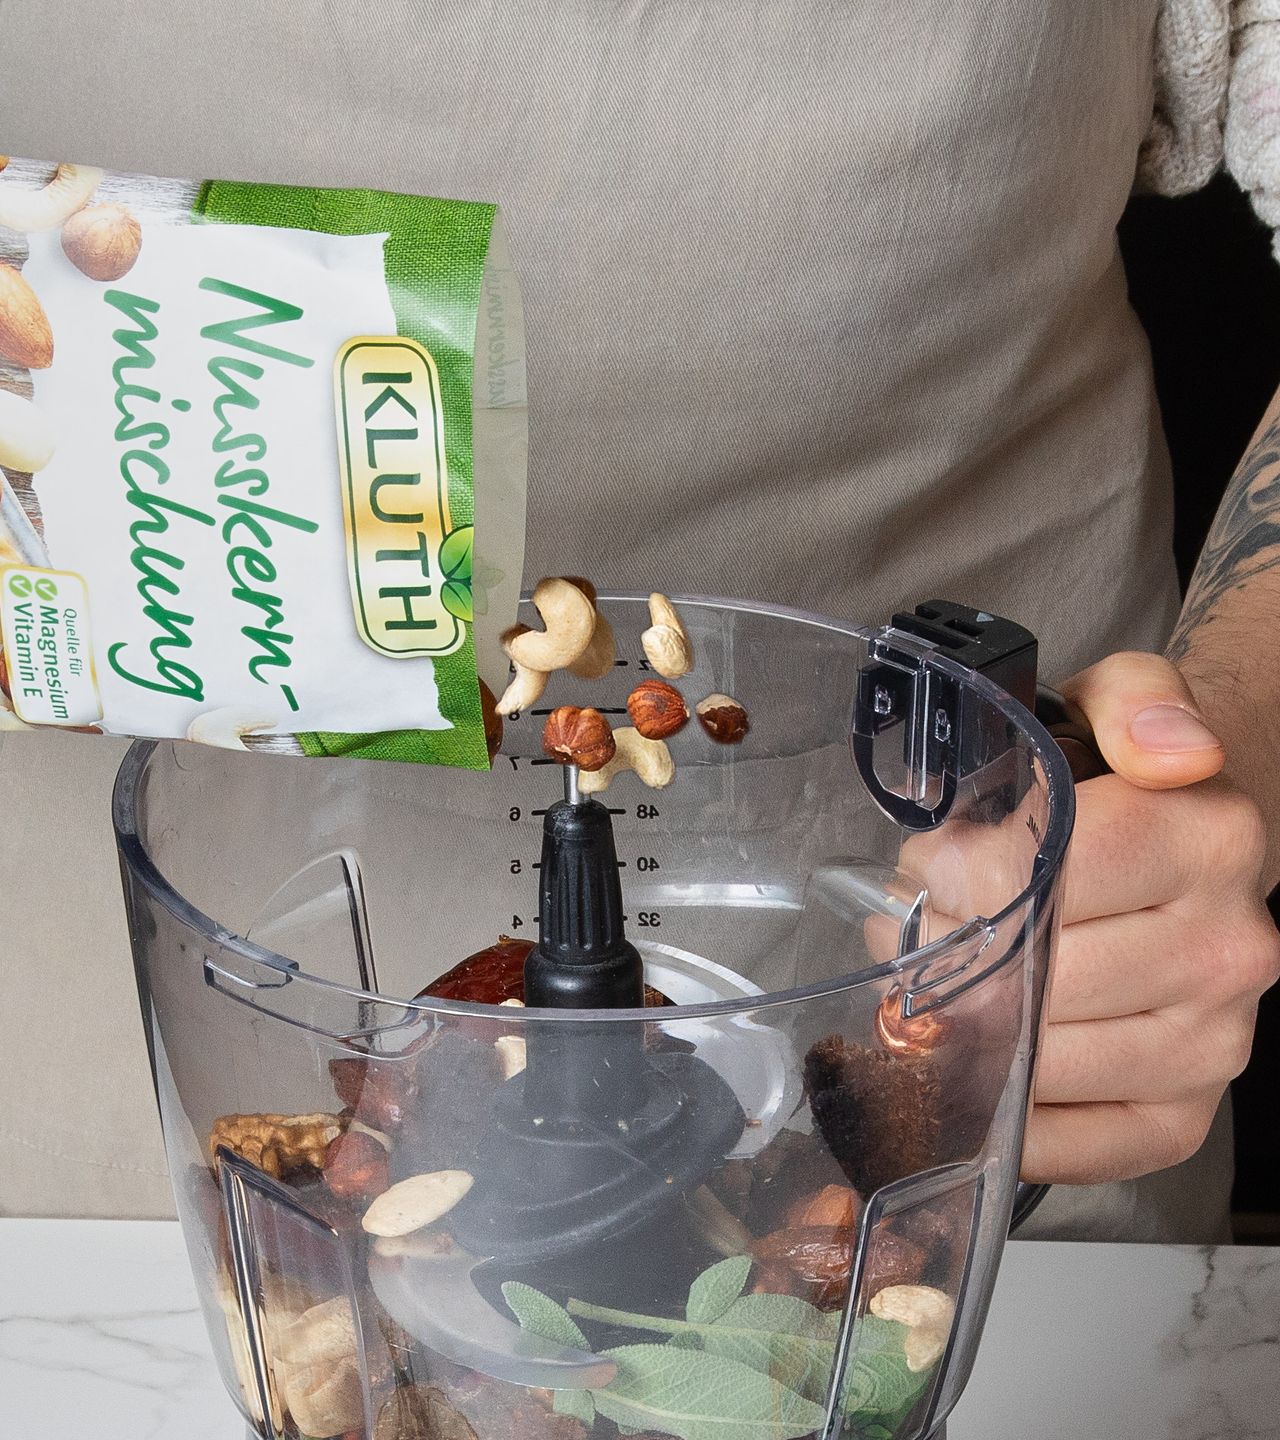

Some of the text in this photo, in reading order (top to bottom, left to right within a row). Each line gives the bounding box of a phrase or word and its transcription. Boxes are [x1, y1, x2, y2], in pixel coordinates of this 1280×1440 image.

[103, 289, 216, 702] mischung
[198, 277, 319, 711] Nusskern-
[361, 371, 438, 631] KLUTH
[13, 602, 44, 698] Vitamin E
[37, 604, 70, 719] Magnesium
[62, 607, 83, 677] Quelle für
